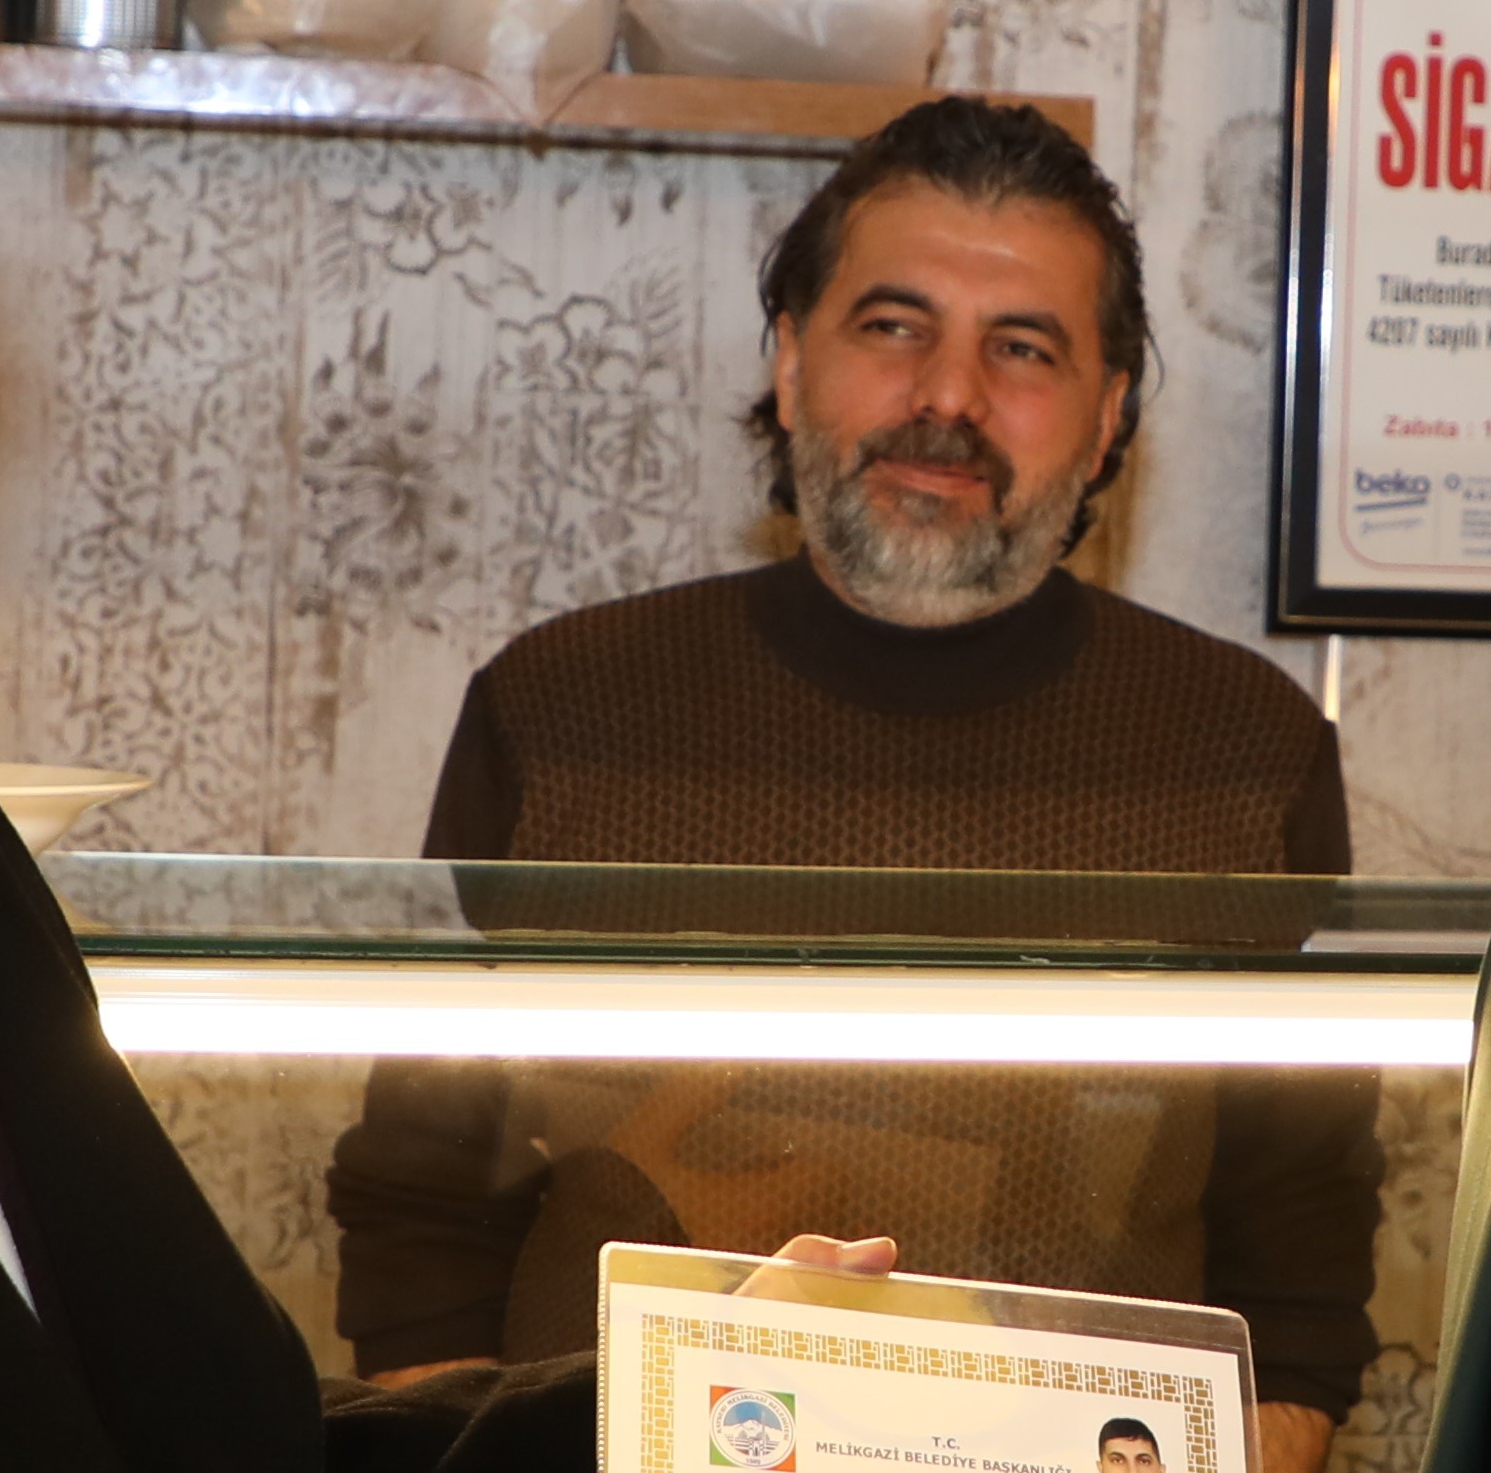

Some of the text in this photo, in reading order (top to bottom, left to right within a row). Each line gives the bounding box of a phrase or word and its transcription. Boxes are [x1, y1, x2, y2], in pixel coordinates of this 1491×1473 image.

[1426, 321, 1479, 355] sayılı
[1355, 467, 1432, 495] beko
[816, 1441, 900, 1461] MELİKGAZİ
[904, 1451, 977, 1470] BELEDİYE
[932, 1436, 961, 1450] T.C.
